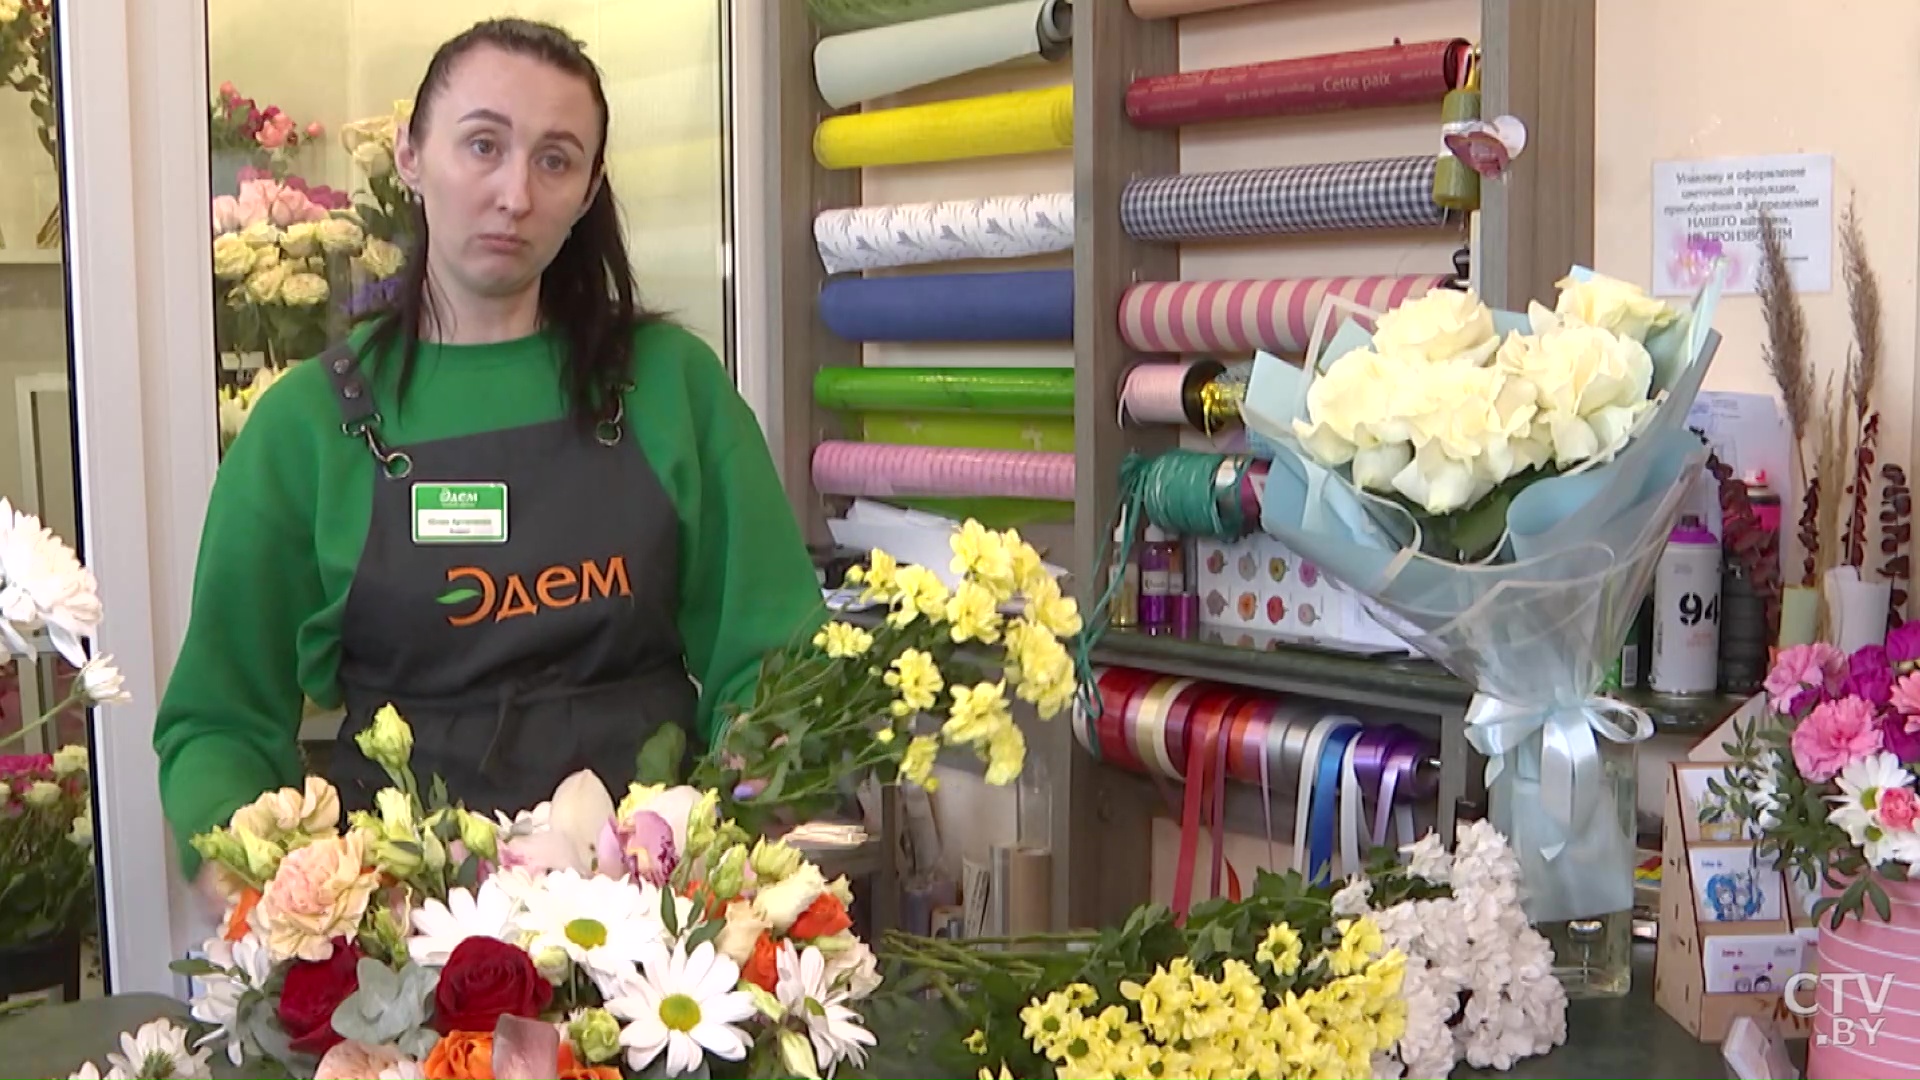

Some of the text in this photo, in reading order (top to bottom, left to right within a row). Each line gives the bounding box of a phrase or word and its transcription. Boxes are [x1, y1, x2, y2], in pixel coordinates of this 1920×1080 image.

[1322, 74, 1359, 93] Cette
[1362, 72, 1392, 92] paix
[1688, 216, 1737, 228] НАШЕГО
[438, 488, 478, 504] Эдем
[1679, 591, 1719, 627] 94
